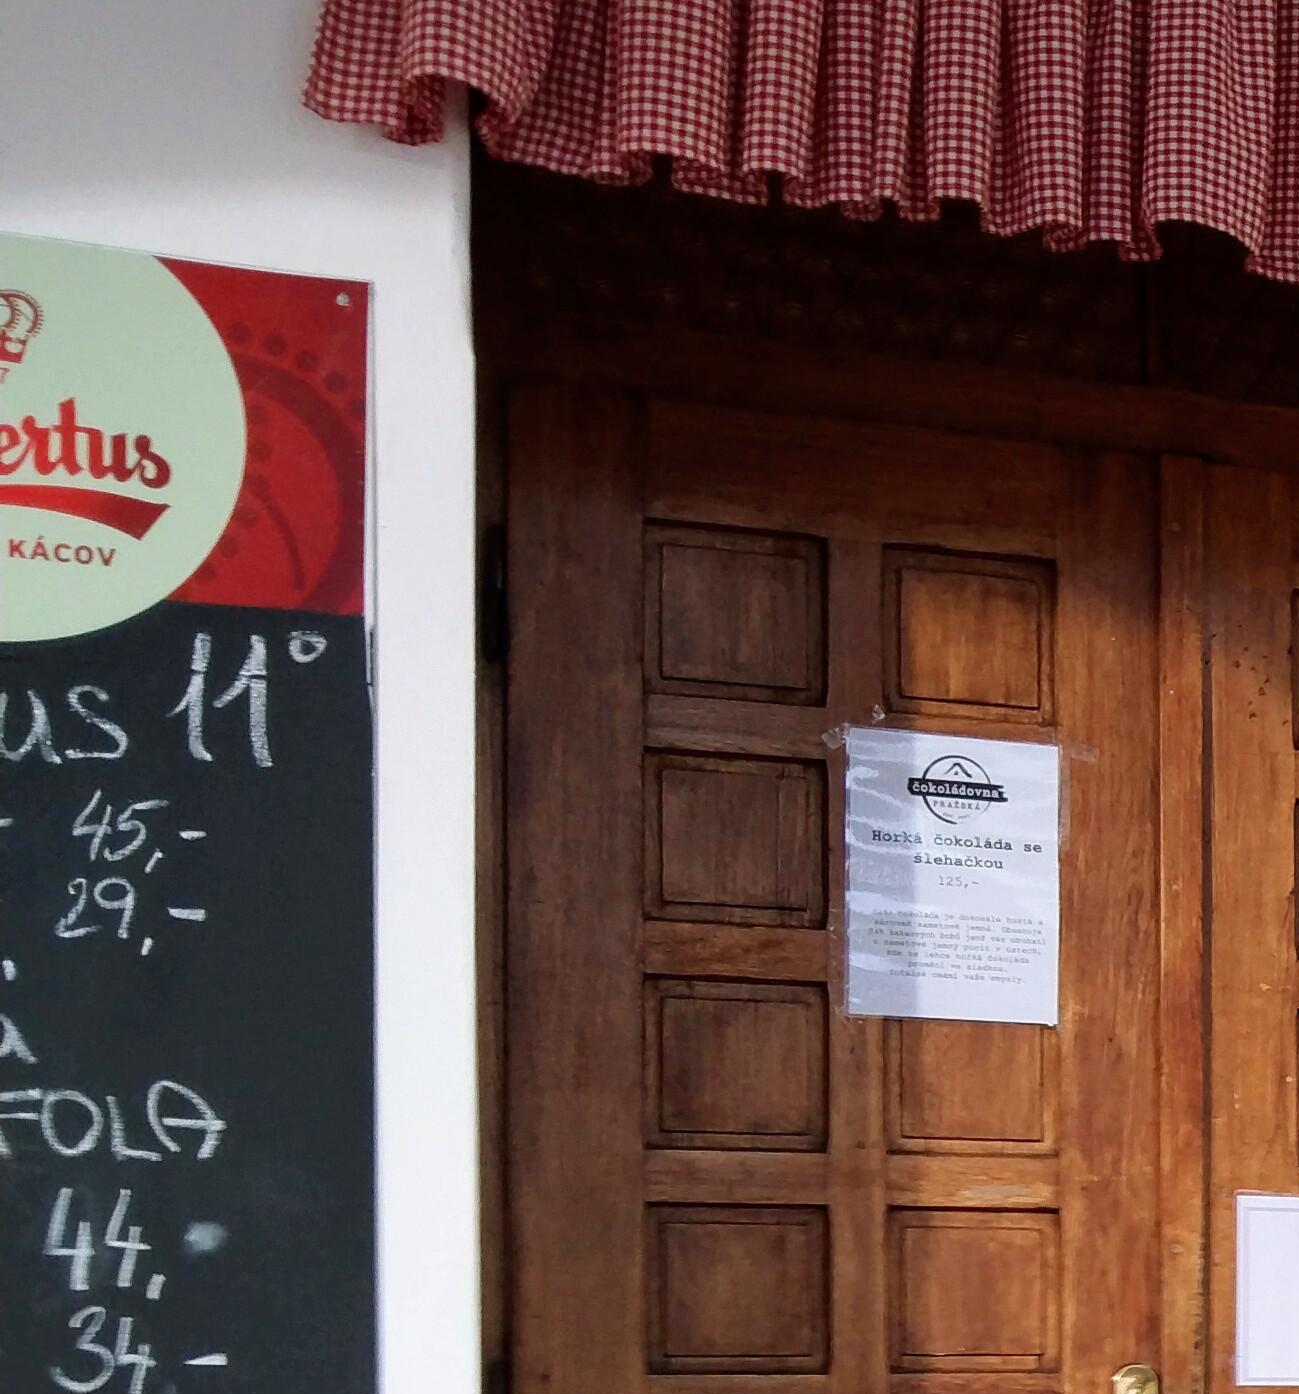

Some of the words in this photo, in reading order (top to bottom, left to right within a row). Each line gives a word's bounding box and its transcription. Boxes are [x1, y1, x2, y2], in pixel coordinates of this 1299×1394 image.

[8, 535, 117, 567] KÁCOV
[872, 830, 923, 844] Horká
[933, 833, 1013, 851] čokoláda
[1023, 843, 1043, 853] se
[912, 852, 1004, 870] šlehačkou
